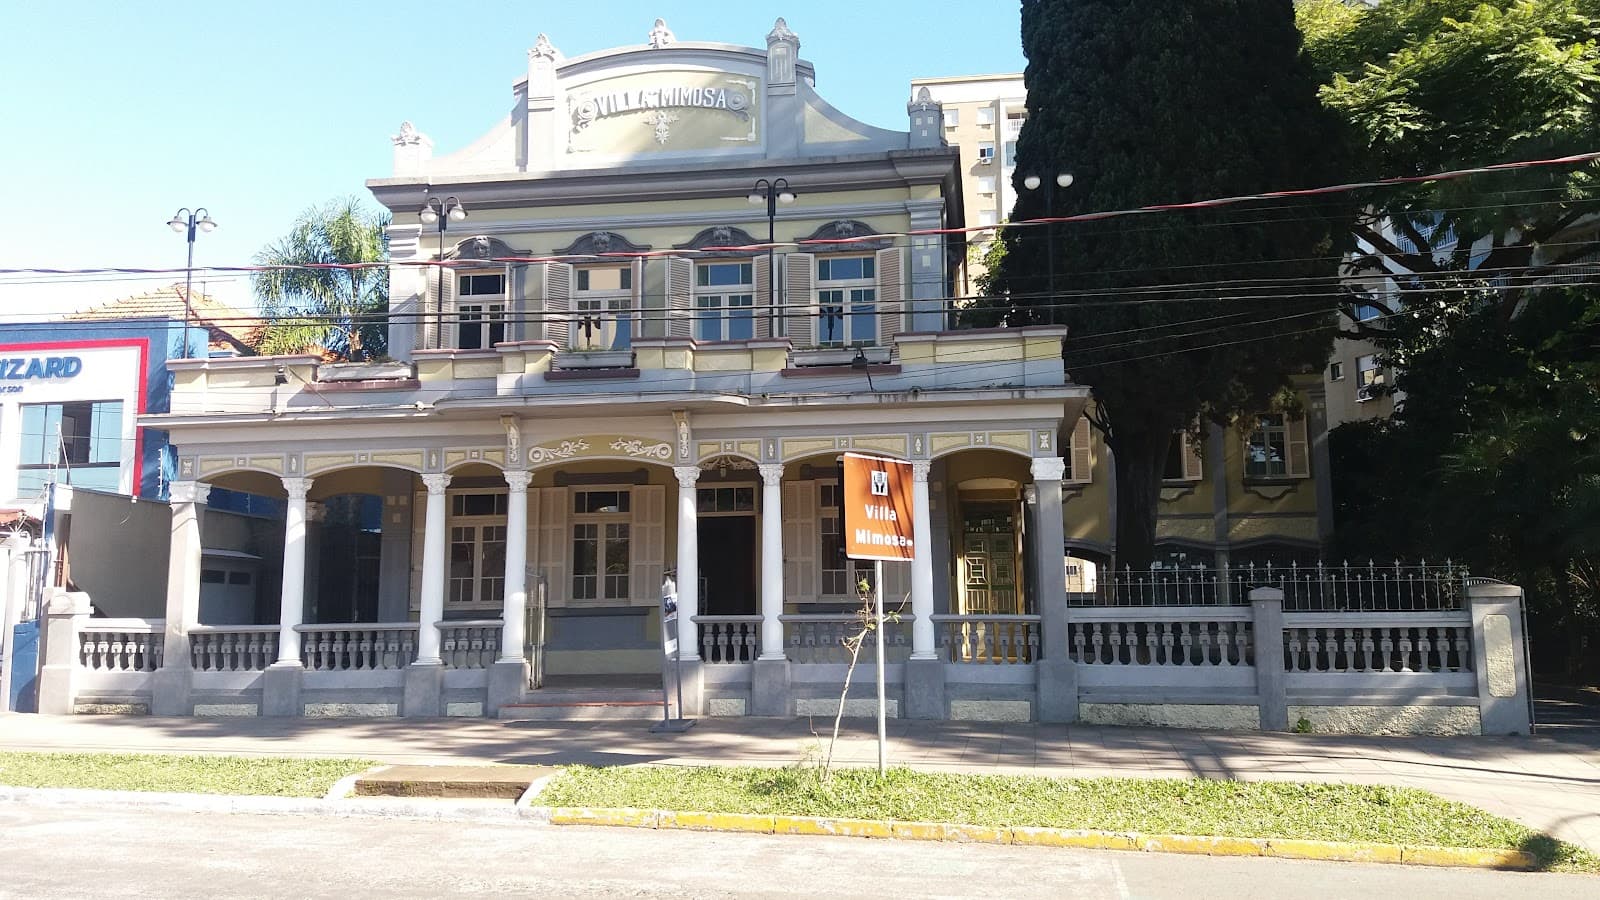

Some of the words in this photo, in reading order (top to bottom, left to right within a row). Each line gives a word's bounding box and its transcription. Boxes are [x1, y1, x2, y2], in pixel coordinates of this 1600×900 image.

[594, 88, 649, 116] VILLA
[660, 87, 727, 109] MIMOSA
[0, 356, 82, 379] IZARD
[864, 503, 897, 521] Villa
